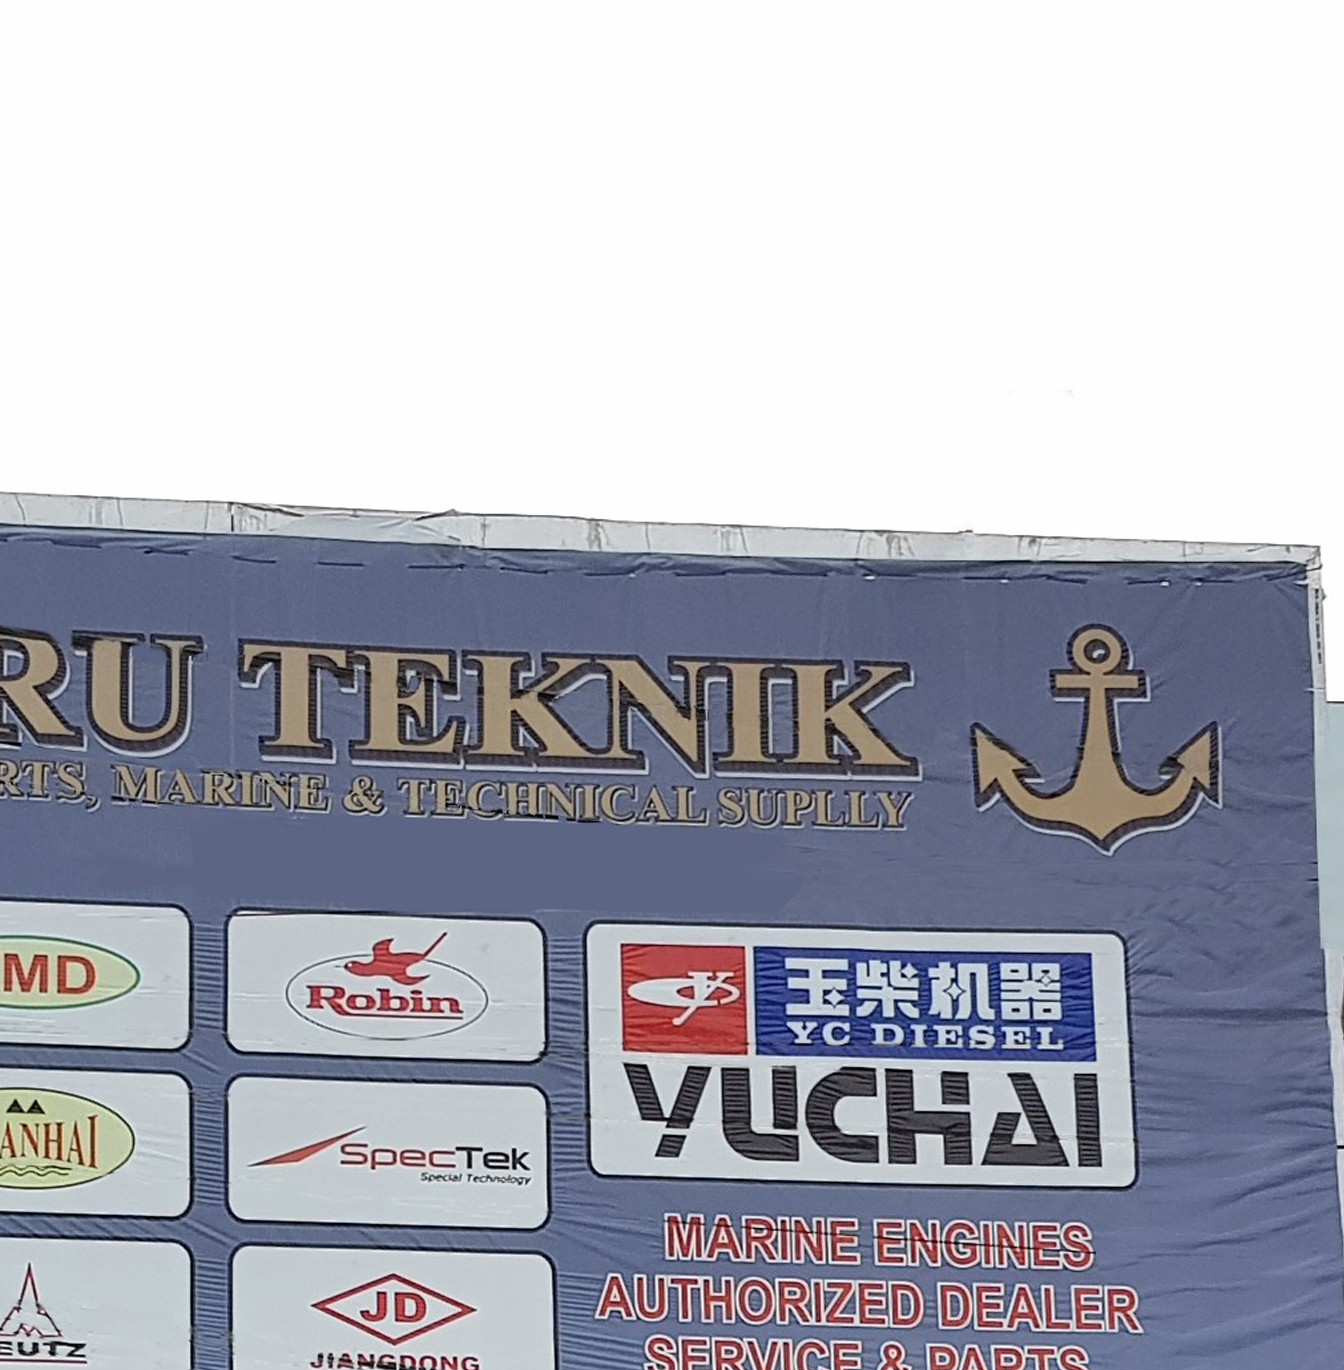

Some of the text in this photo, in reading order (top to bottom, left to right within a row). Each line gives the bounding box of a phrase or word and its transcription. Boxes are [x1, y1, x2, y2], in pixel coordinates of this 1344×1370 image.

[238, 637, 922, 779] TEKNIK
[113, 763, 330, 813] MARINE
[342, 775, 388, 816] &
[398, 778, 708, 826] TECHNICAL
[717, 786, 913, 831] SUPLLY
[306, 982, 465, 1020] Robin
[785, 956, 1062, 1022] 玉柴机器
[789, 1023, 1064, 1051] YC DIESEL
[622, 1062, 1103, 1168] YUCHAI
[339, 1143, 531, 1171] SpecTek
[420, 1172, 532, 1187] Special Technology
[663, 1212, 1096, 1271] MARINE ENGINES
[359, 1291, 428, 1324] JD
[595, 1274, 1144, 1334] AUTHORIZED DEALER
